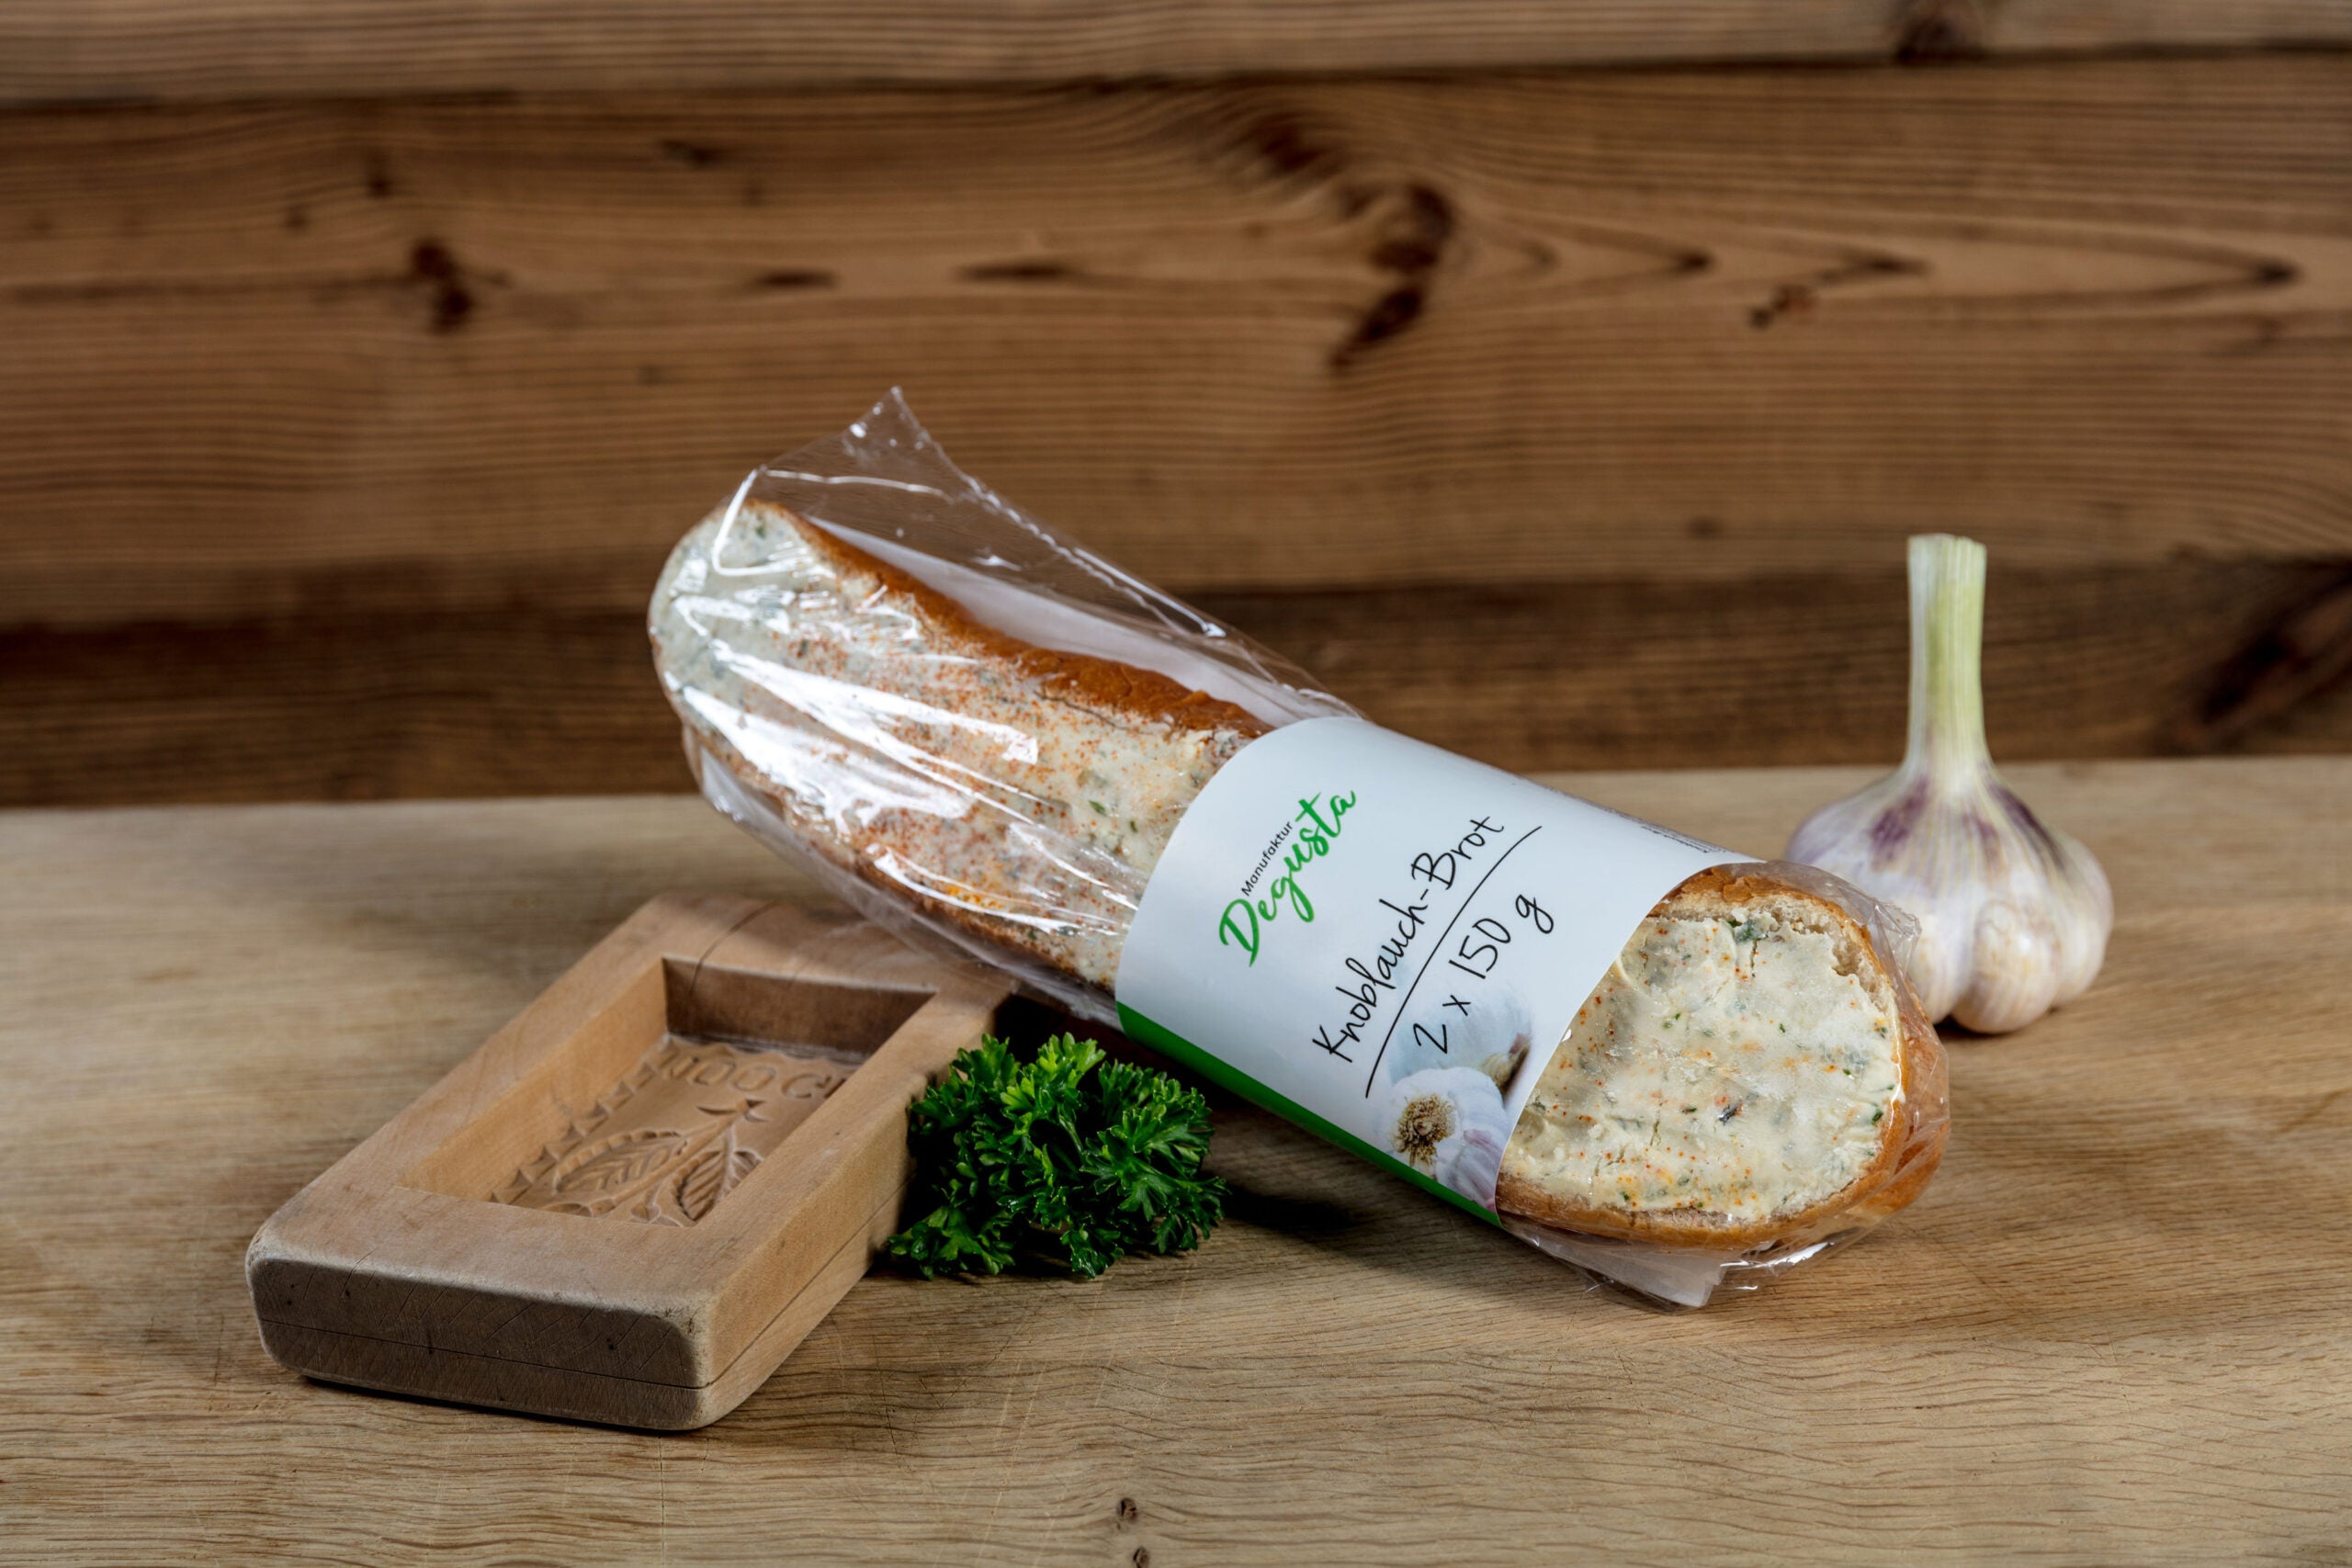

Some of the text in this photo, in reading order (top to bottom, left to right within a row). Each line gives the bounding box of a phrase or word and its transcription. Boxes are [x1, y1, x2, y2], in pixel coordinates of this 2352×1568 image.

[1218, 790, 1357, 967] Degusta
[1240, 821, 1294, 897] Manufaktur
[1312, 816, 1505, 1063] Knoblauch-Brot
[1412, 894, 1555, 1055] 2 x 150 g
